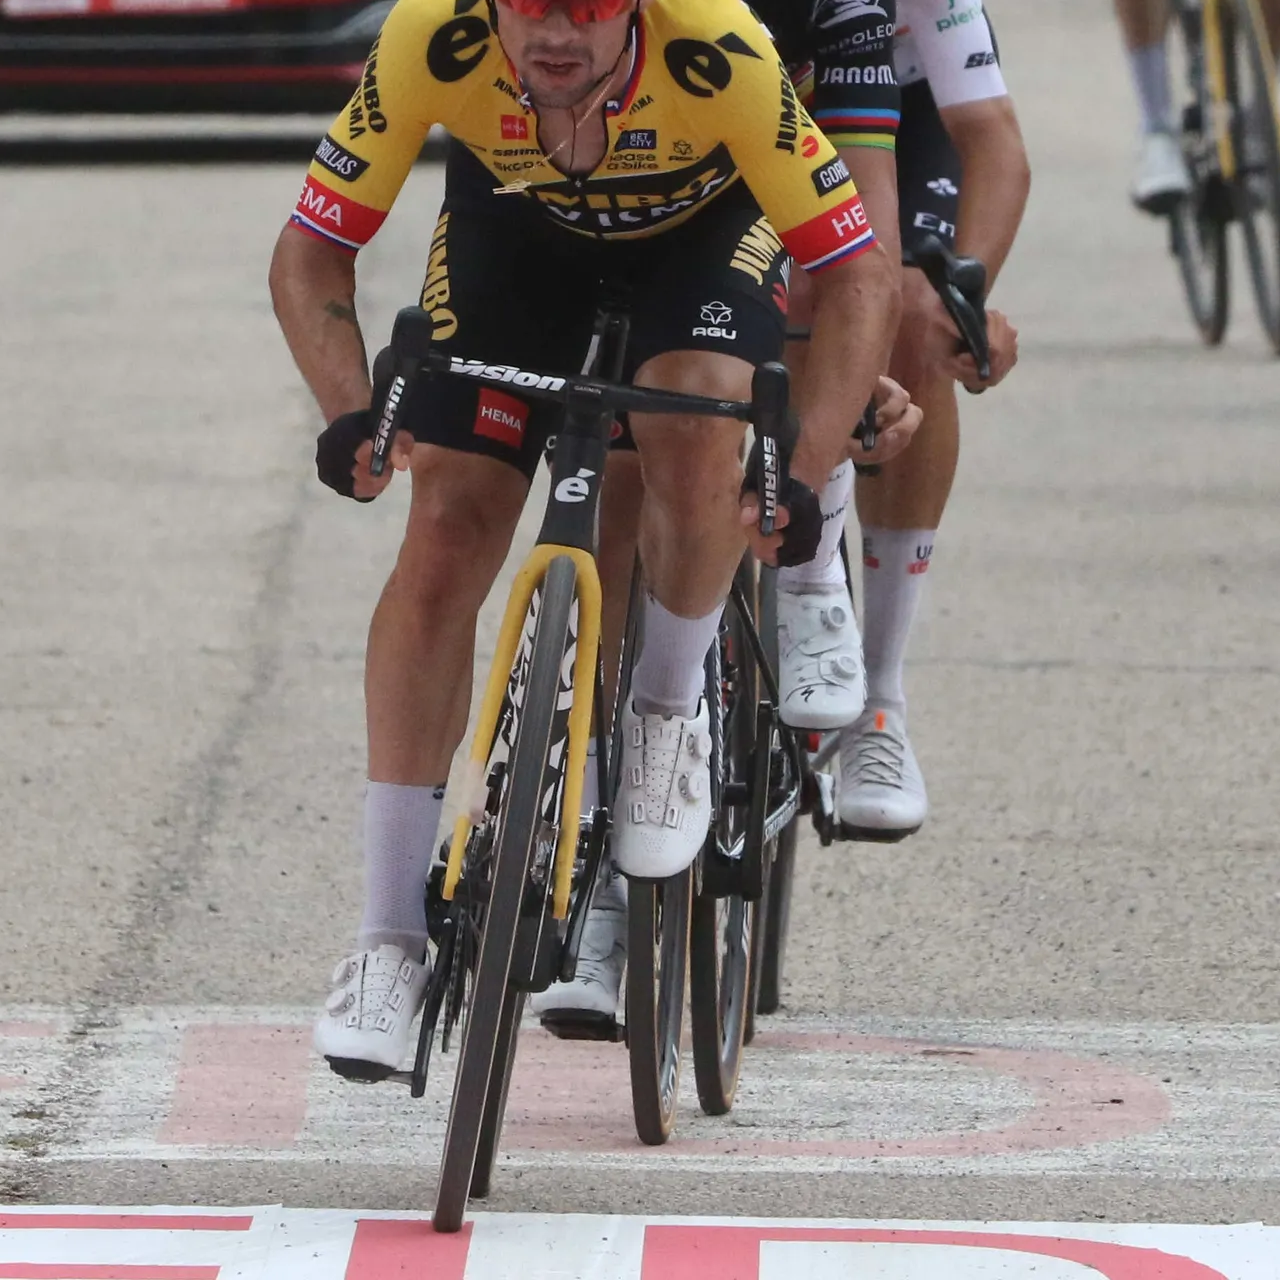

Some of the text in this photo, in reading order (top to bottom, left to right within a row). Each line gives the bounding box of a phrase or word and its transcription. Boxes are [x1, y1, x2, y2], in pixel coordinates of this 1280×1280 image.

[629, 132, 649, 141] BET
[629, 139, 652, 148] CITY
[692, 327, 737, 341] AGU
[481, 405, 522, 433] HEMA
